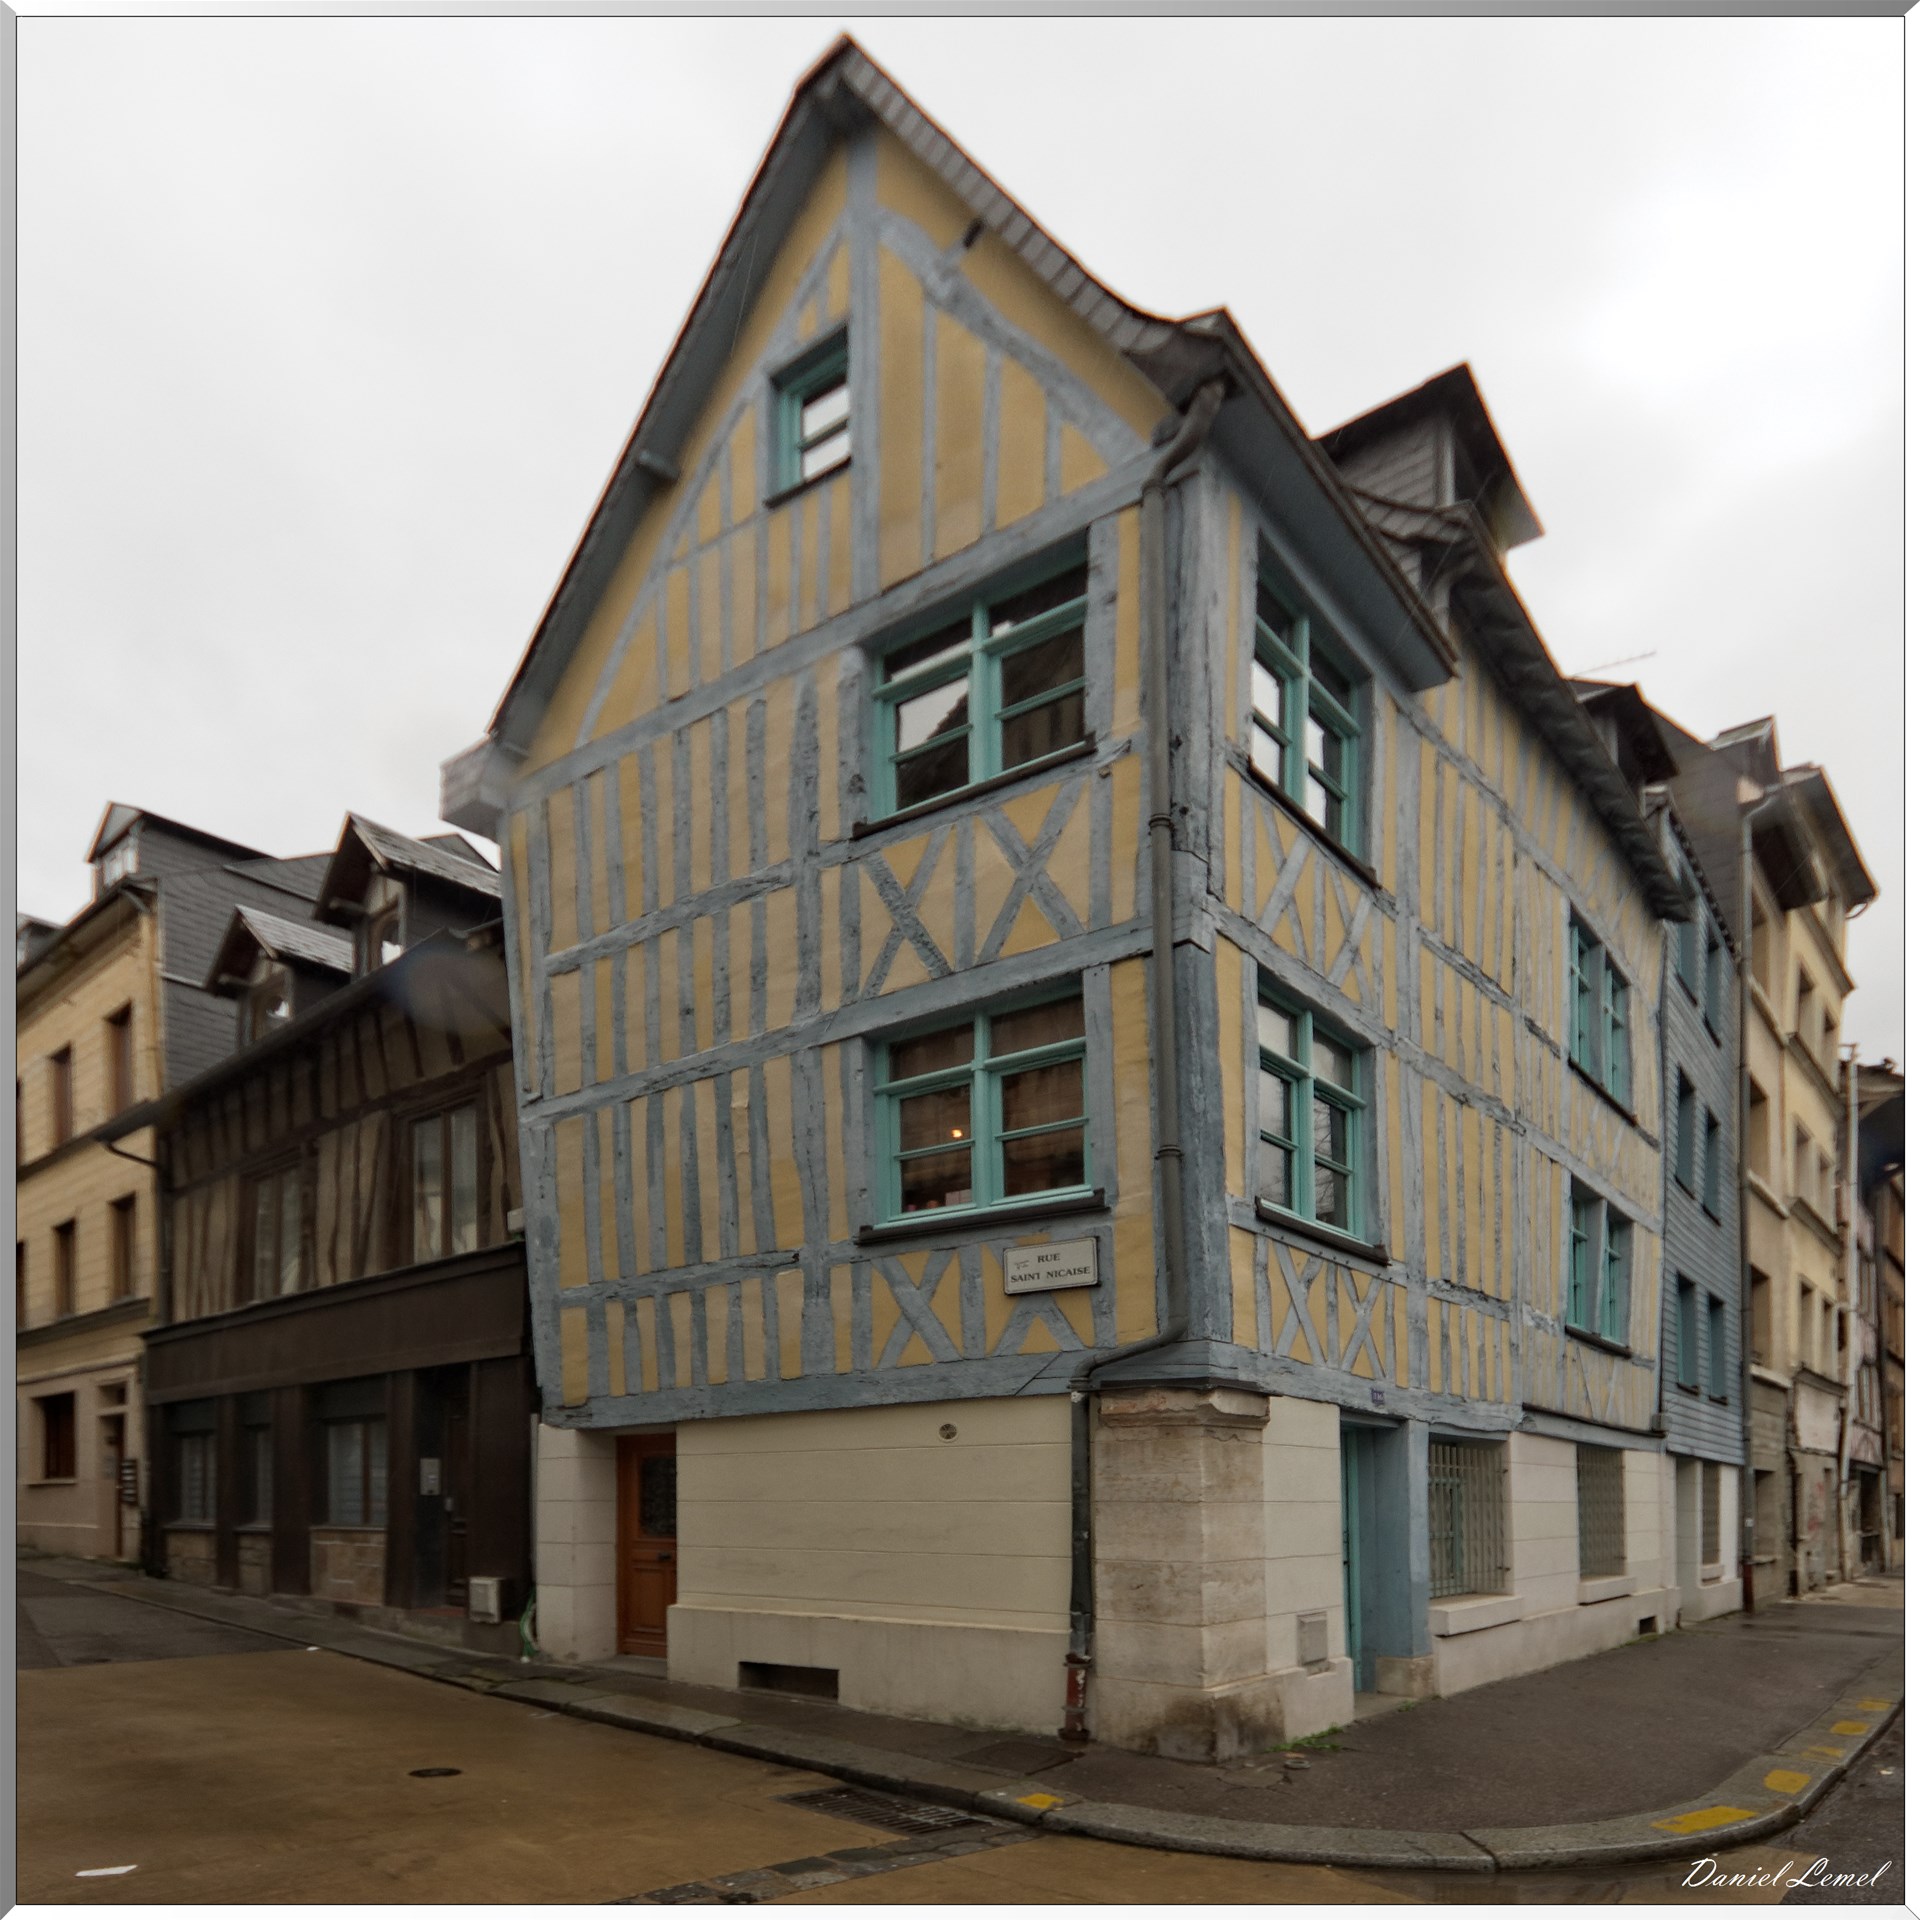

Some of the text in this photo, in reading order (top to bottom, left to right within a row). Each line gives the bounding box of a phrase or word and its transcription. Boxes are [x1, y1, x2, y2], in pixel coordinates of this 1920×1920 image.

[1037, 1253, 1060, 1263] RUE
[1010, 1266, 1091, 1283] SAINT NICAISE
